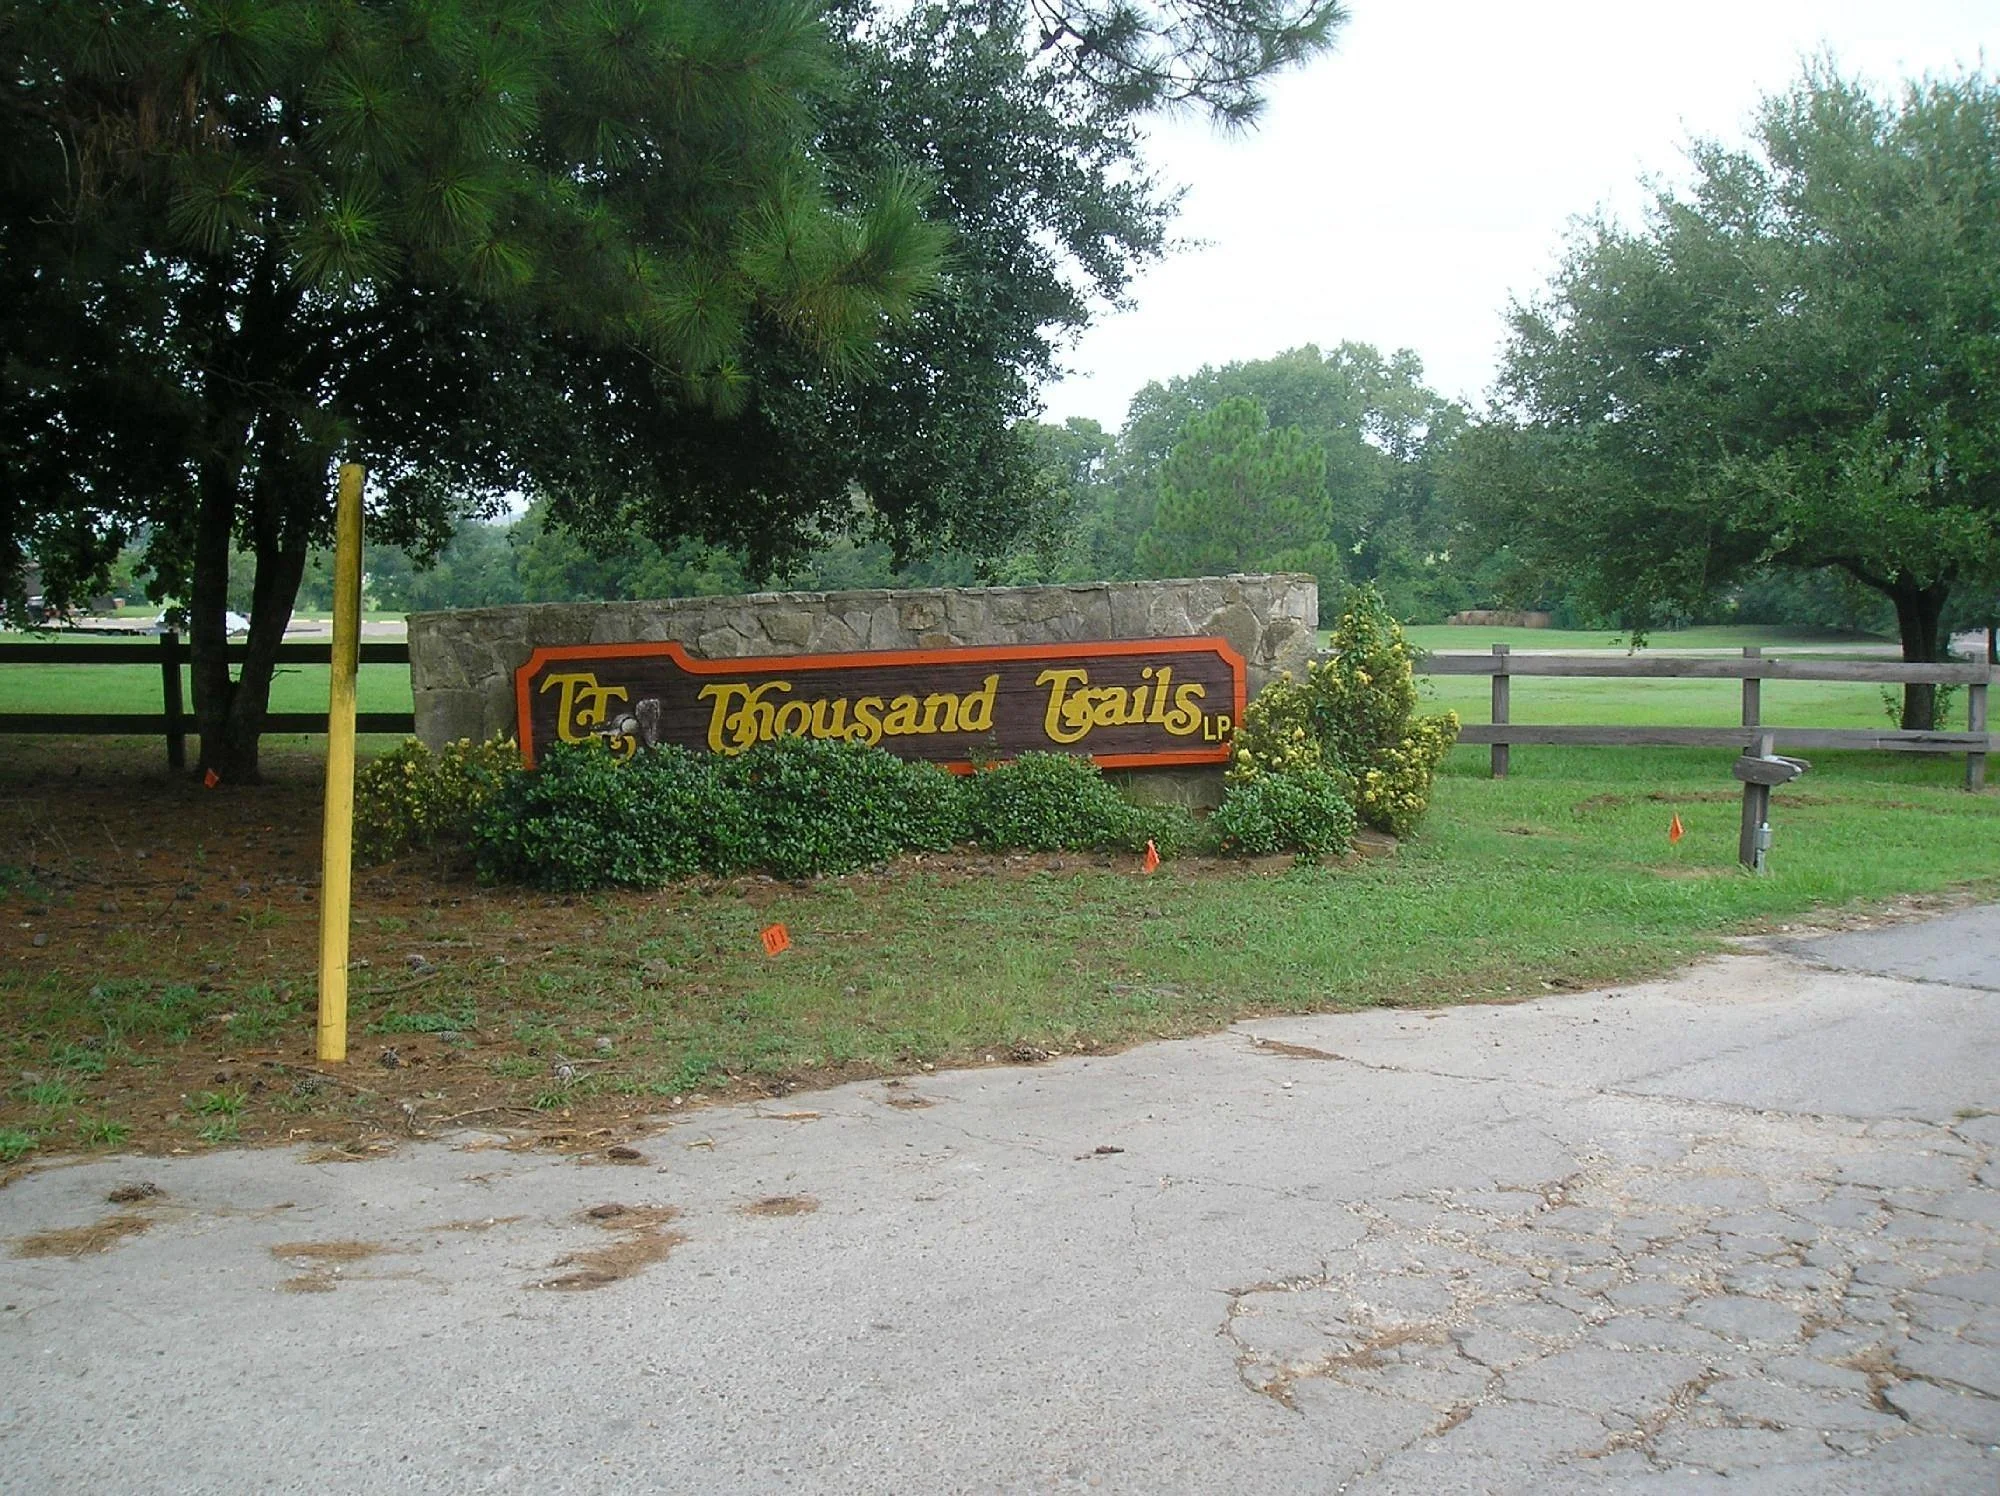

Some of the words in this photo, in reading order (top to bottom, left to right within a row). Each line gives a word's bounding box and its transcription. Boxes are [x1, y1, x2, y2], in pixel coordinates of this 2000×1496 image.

[698, 674, 999, 756] Thousand
[1035, 666, 1206, 744] Trails
[1203, 714, 1231, 741] LP
